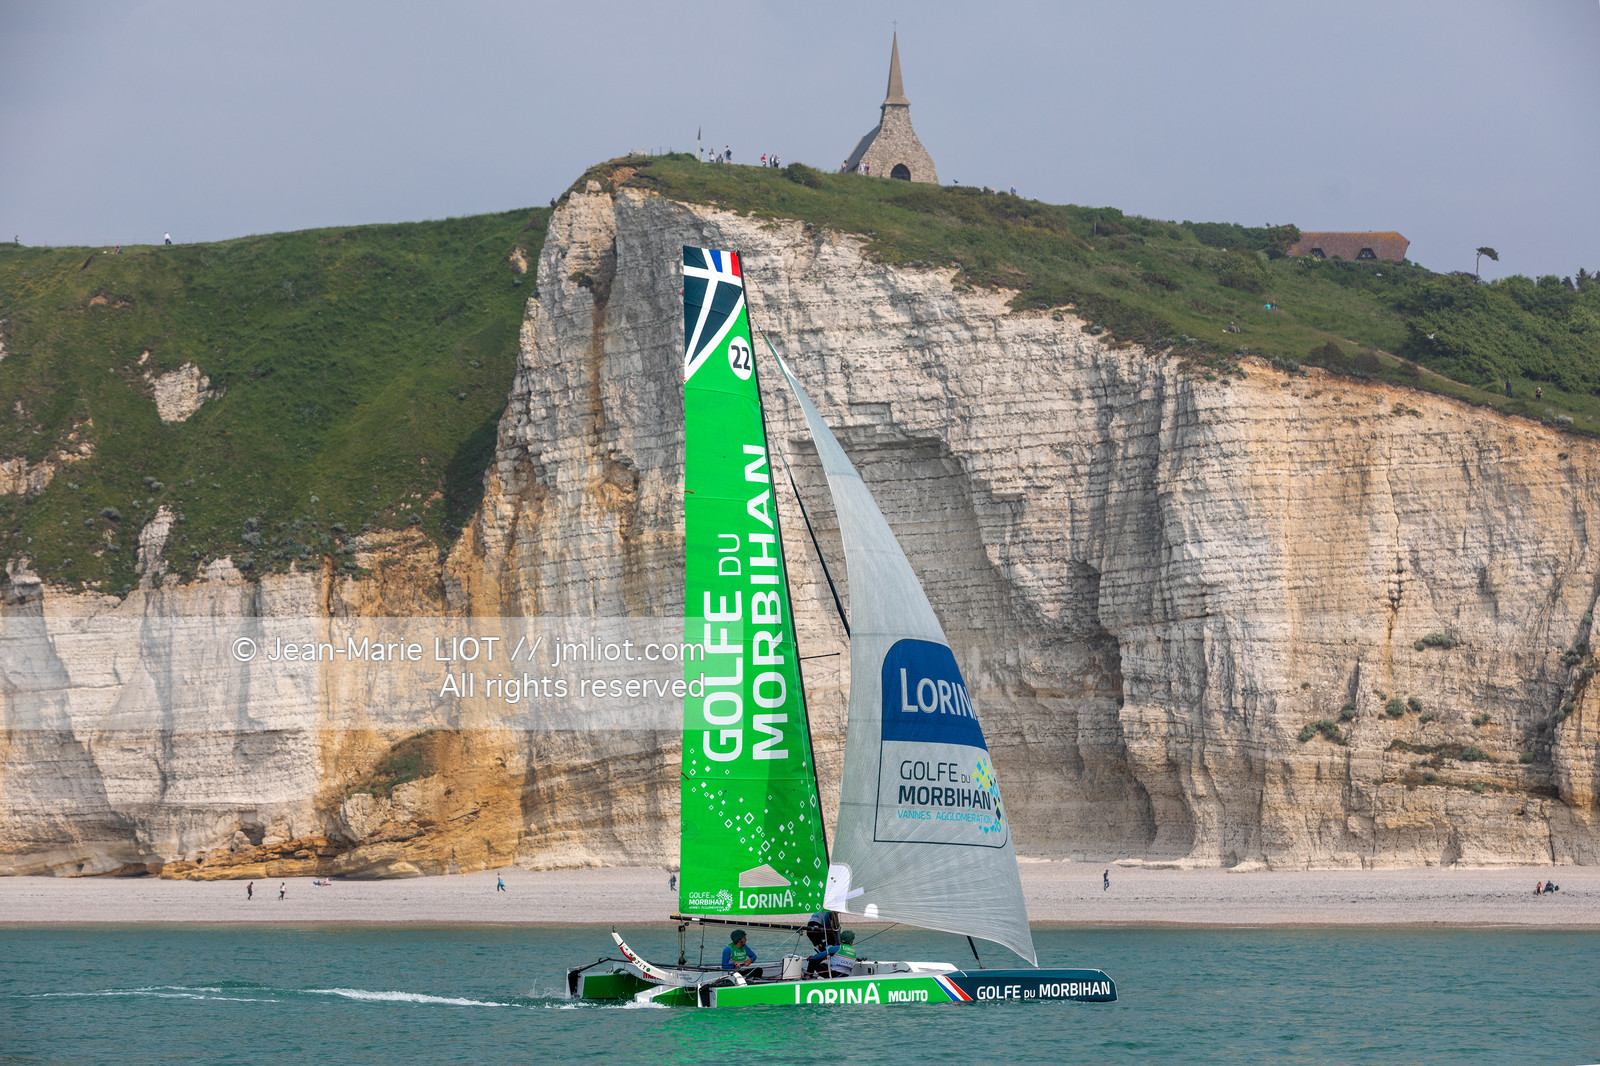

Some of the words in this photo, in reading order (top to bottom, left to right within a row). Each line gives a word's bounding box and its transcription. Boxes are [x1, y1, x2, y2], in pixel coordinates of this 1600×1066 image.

[730, 344, 751, 371] 22
[717, 533, 742, 576] DU
[742, 444, 789, 760] MORBIHAN
[702, 590, 744, 762] GOLFE
[900, 760, 958, 783] GOLFE
[961, 773, 971, 784] DU
[898, 785, 992, 811] MORBIHAN
[897, 809, 931, 820] VANNES
[688, 898, 725, 906] MORBIHAN
[689, 891, 710, 899] GOLFE
[739, 889, 794, 909] LORINA
[795, 982, 880, 1004] LORINA
[888, 989, 928, 1003] MOJITO
[976, 985, 1022, 1000] GOLFE
[1024, 989, 1036, 999] DU
[1039, 981, 1111, 998] MORBIHAN
